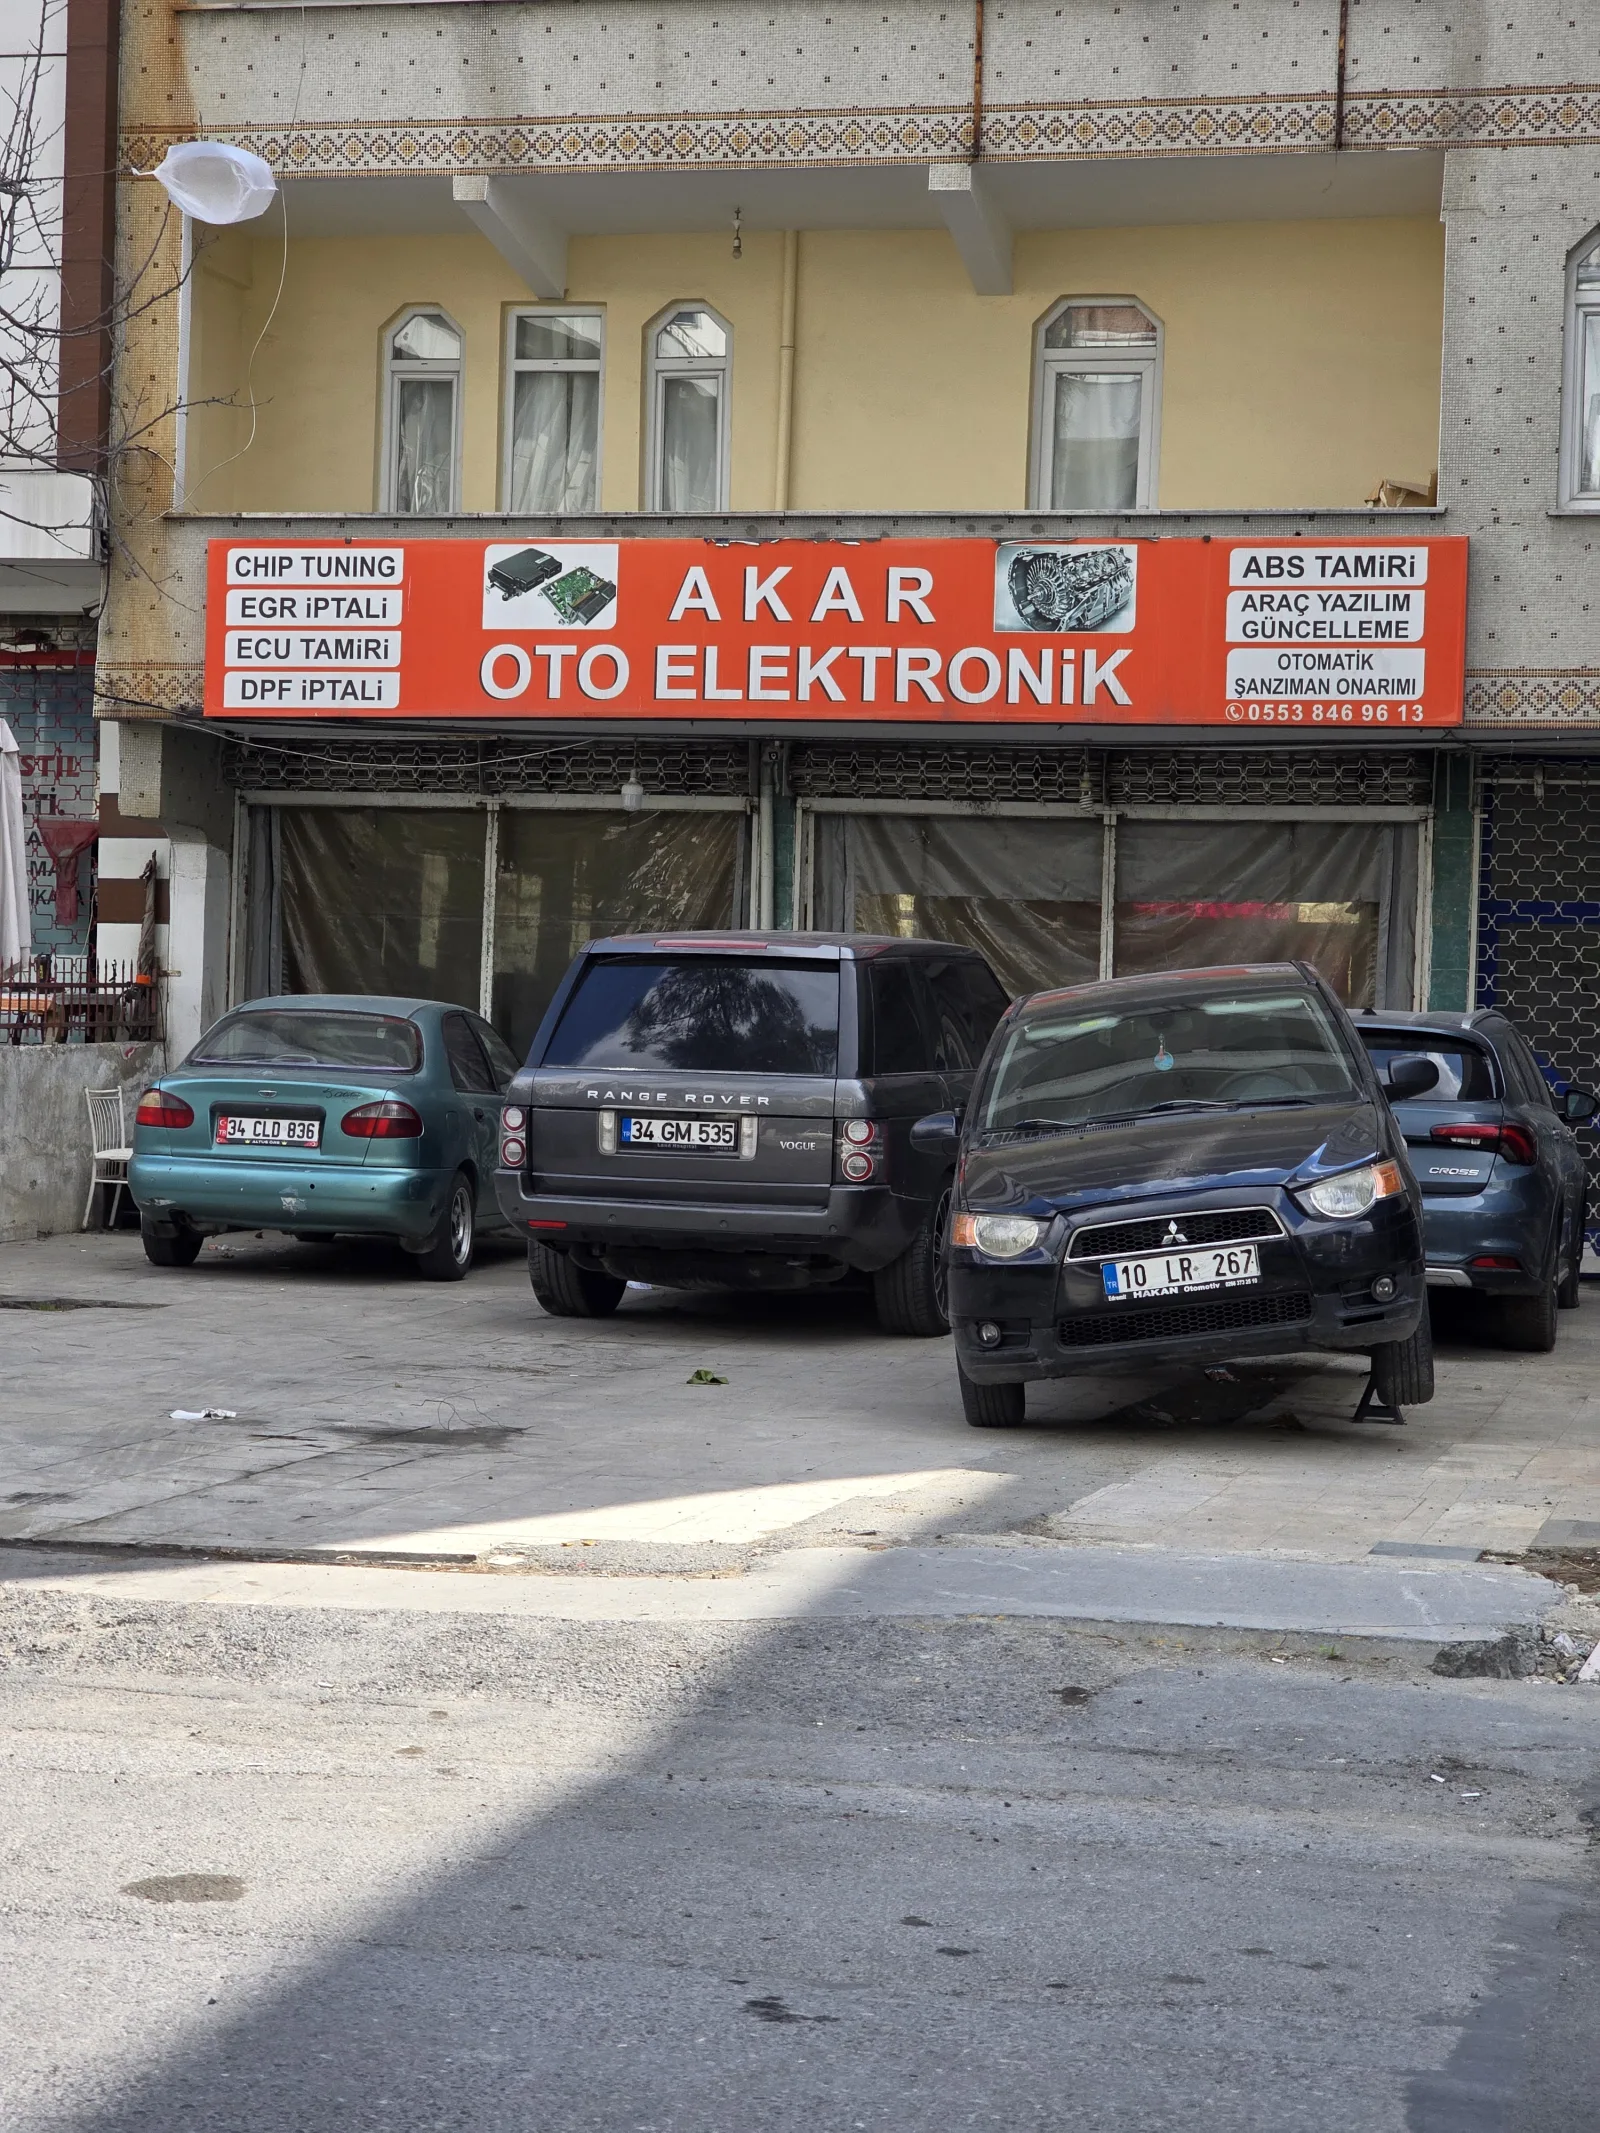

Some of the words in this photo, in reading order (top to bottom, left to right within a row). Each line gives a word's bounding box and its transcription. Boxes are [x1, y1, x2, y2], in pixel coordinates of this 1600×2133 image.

[236, 555, 293, 578] CHIP
[301, 555, 396, 578] TUNING
[1242, 555, 1305, 579] ABS
[240, 596, 297, 620] EGR
[1240, 593, 1310, 617] ARAÇ
[1316, 593, 1412, 612] YAZILIM
[1242, 616, 1410, 640] GÜNCELLEME
[236, 637, 291, 661] ECU
[1276, 650, 1375, 672] OTOMATİK
[480, 643, 630, 701] OTO
[655, 645, 1134, 707] ELEKTRONiK
[240, 678, 293, 702] DPF
[1234, 678, 1330, 699] ŞANZIMAN
[1336, 677, 1417, 696] ONARIMI
[1248, 703, 1304, 721] 0553
[1311, 703, 1353, 722] 846
[1361, 704, 1389, 722] 96
[1397, 704, 1425, 722] 13
[587, 1089, 667, 1102] RANGE
[685, 1093, 770, 1106] ROVER
[218, 1129, 227, 1137] TR
[228, 1119, 246, 1137] 34
[252, 1120, 281, 1138] CLD
[287, 1121, 316, 1139] 836
[632, 1120, 654, 1141] 34
[661, 1121, 692, 1142] GM
[698, 1123, 734, 1144] 535
[780, 1140, 817, 1151] VOGUE
[1428, 1166, 1480, 1176] CROSS
[1107, 1281, 1118, 1289] TR
[1121, 1263, 1147, 1289] 10
[1166, 1257, 1193, 1284] LR
[1212, 1249, 1253, 1277] 267
[1133, 1286, 1179, 1299] HAKAN
[1183, 1282, 1220, 1293] Otomotiv
